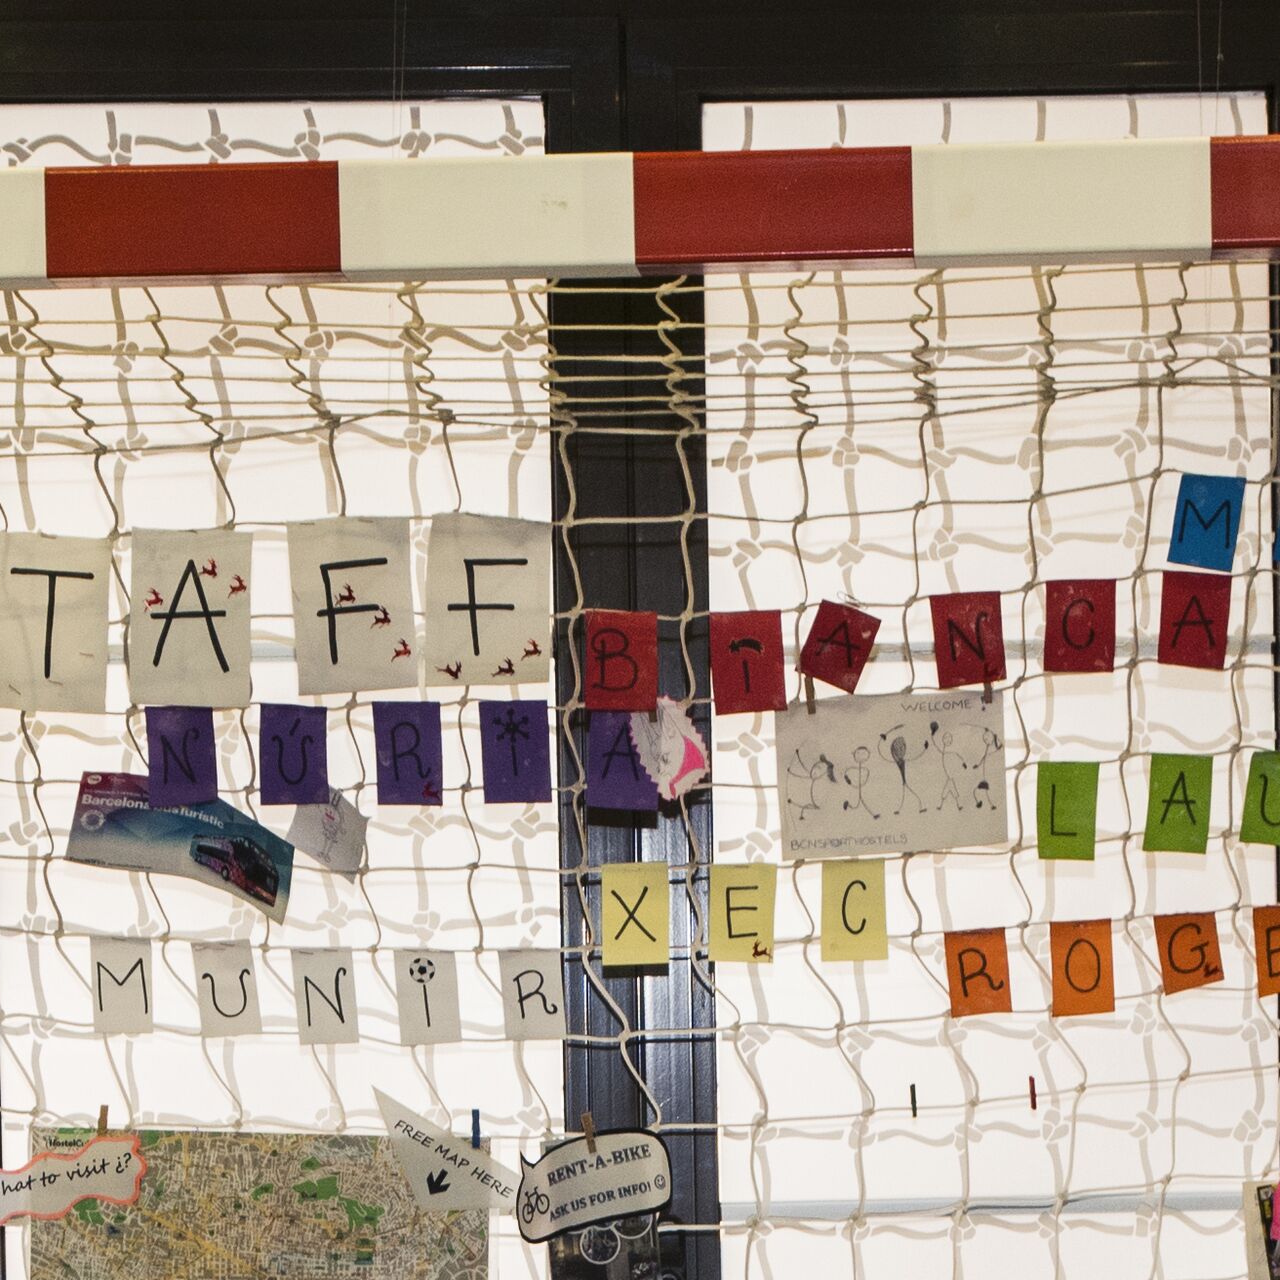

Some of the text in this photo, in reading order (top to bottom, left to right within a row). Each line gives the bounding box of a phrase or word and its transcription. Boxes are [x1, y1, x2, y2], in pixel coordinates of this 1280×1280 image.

[901, 701, 971, 712] WELCOME
[612, 879, 866, 942] XEC
[97, 957, 558, 1028] MUNIR
[40, 1171, 60, 1188] to
[67, 1158, 111, 1181] visit
[394, 1118, 515, 1198] FREE MAP HERE
[547, 1144, 651, 1187] RENT-A-BIKE
[549, 1182, 651, 1223] ASK US FOR INFO!
